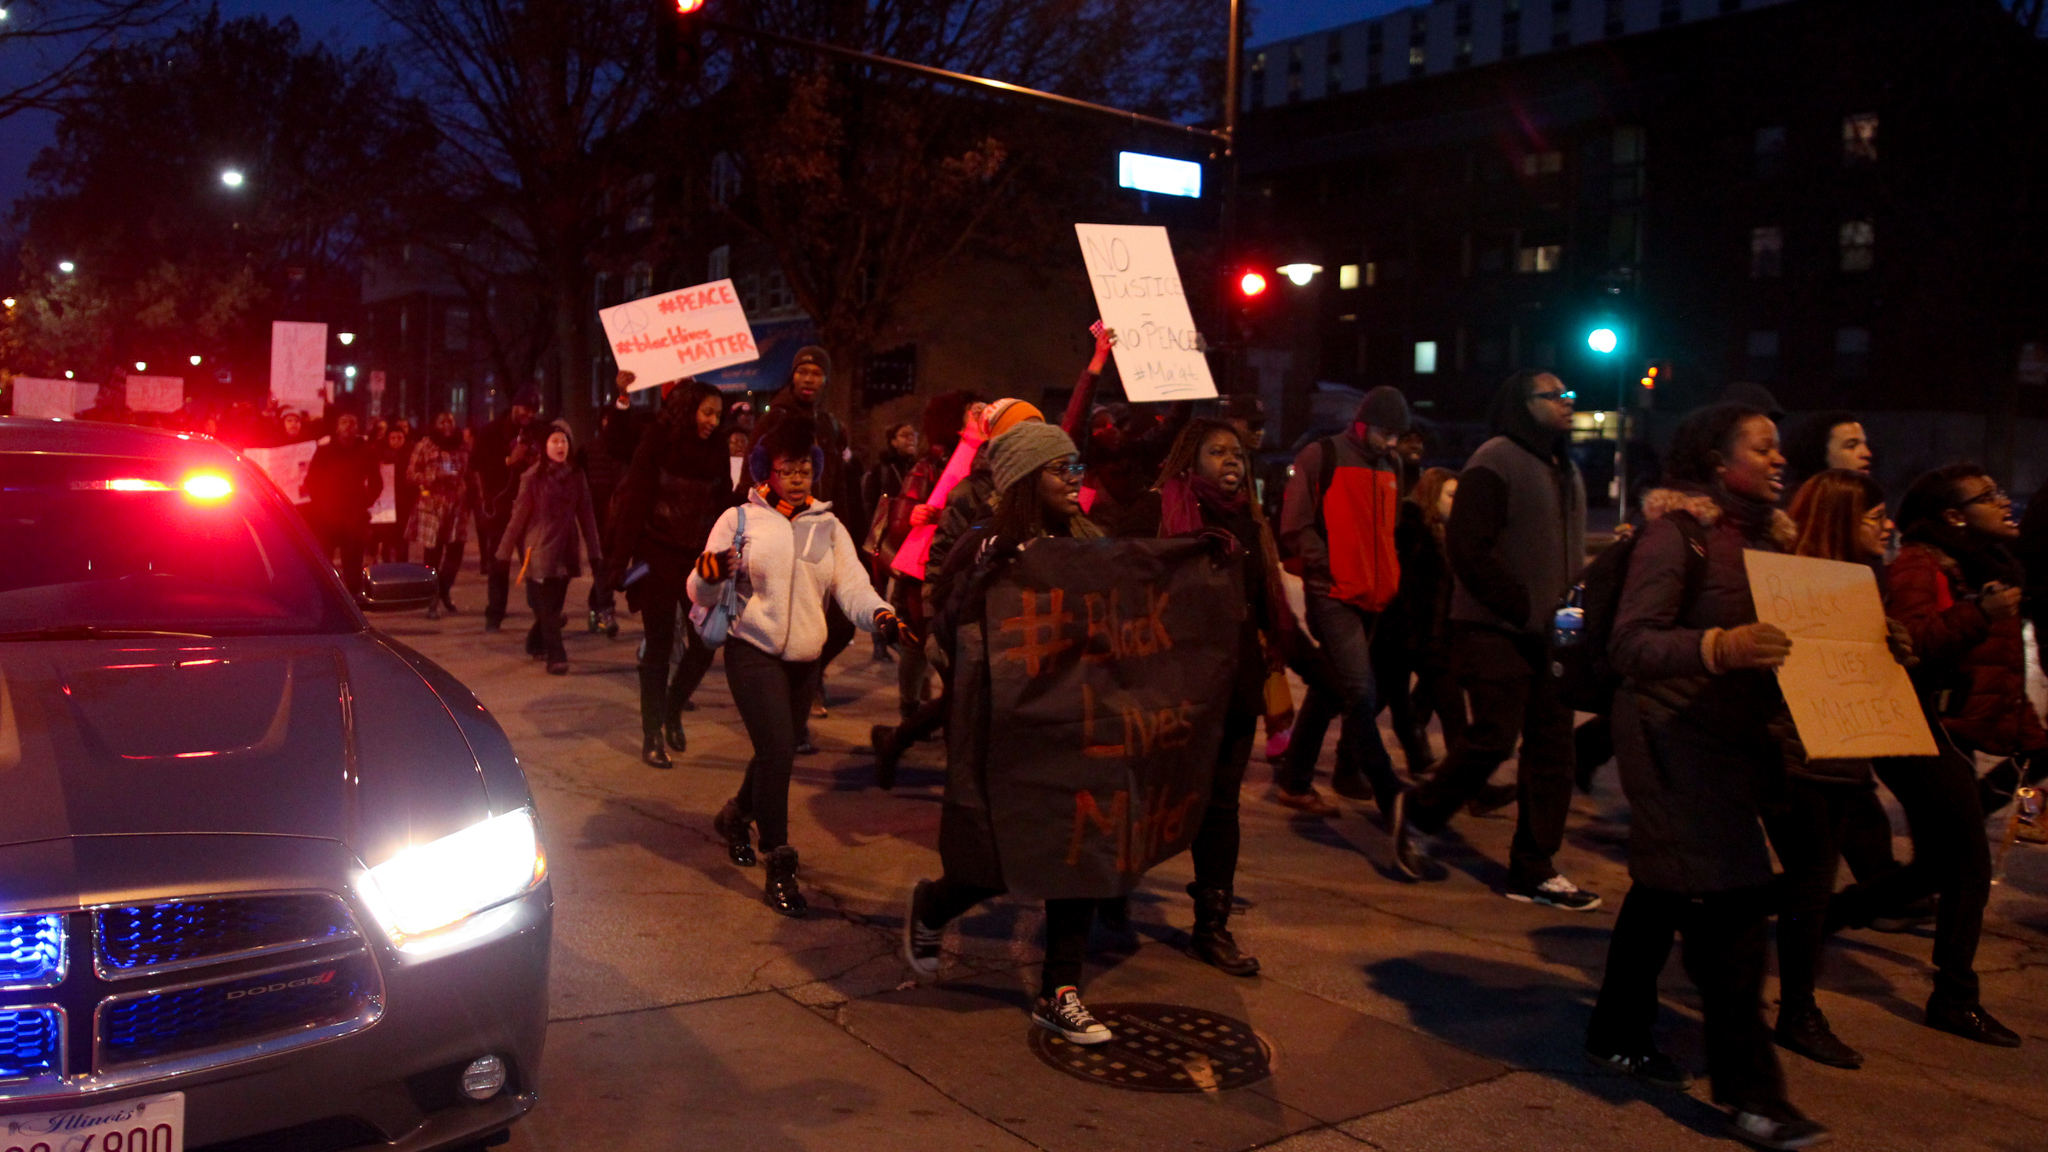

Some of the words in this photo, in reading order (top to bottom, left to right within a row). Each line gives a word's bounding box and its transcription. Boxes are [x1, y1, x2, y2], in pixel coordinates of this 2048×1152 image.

[1087, 236, 1130, 272] NO
[658, 285, 735, 315] #PEACE
[1096, 274, 1183, 299] JUSTICE
[676, 332, 756, 364] MATTER
[1810, 698, 1905, 737] MATTER
[226, 976, 320, 1000] DODGE
[18, 1109, 134, 1136] Illinois
